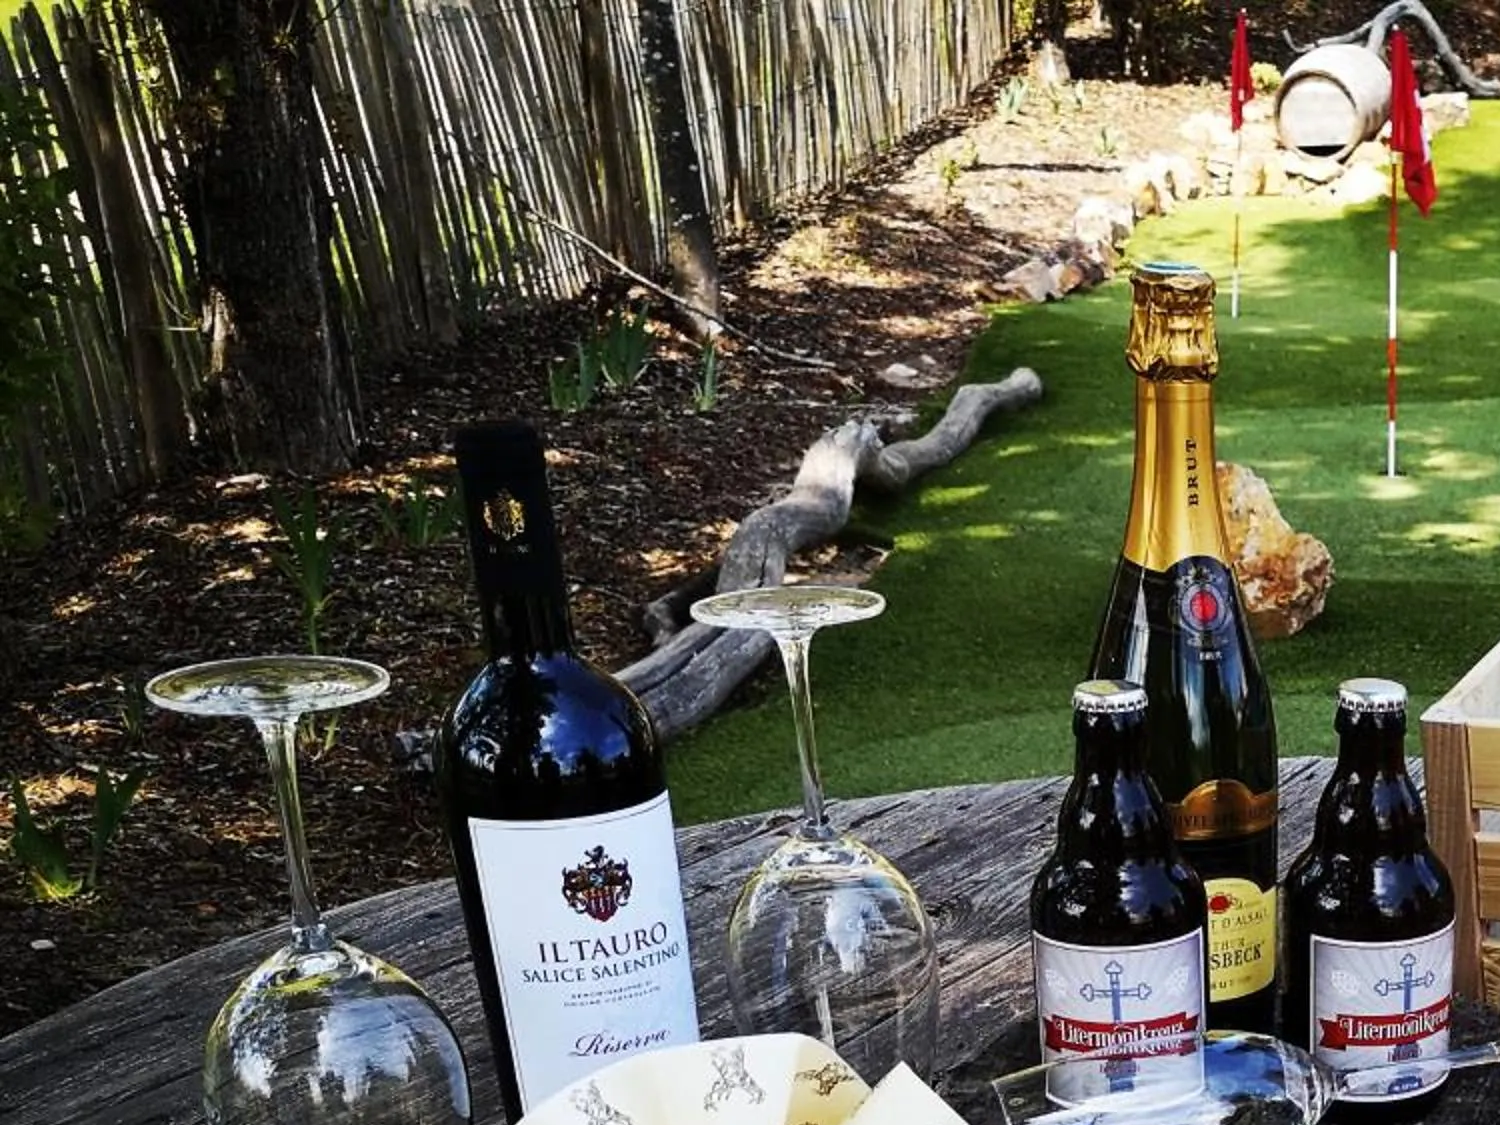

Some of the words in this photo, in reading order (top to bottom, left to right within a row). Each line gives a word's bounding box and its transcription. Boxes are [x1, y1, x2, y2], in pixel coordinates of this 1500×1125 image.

[1186, 437, 1199, 507] BRUT
[521, 967, 587, 984] SALICE
[591, 941, 680, 981] SALENTINO
[538, 941, 569, 964] IL
[569, 921, 668, 962] TAURO
[566, 1028, 671, 1057] Riserva
